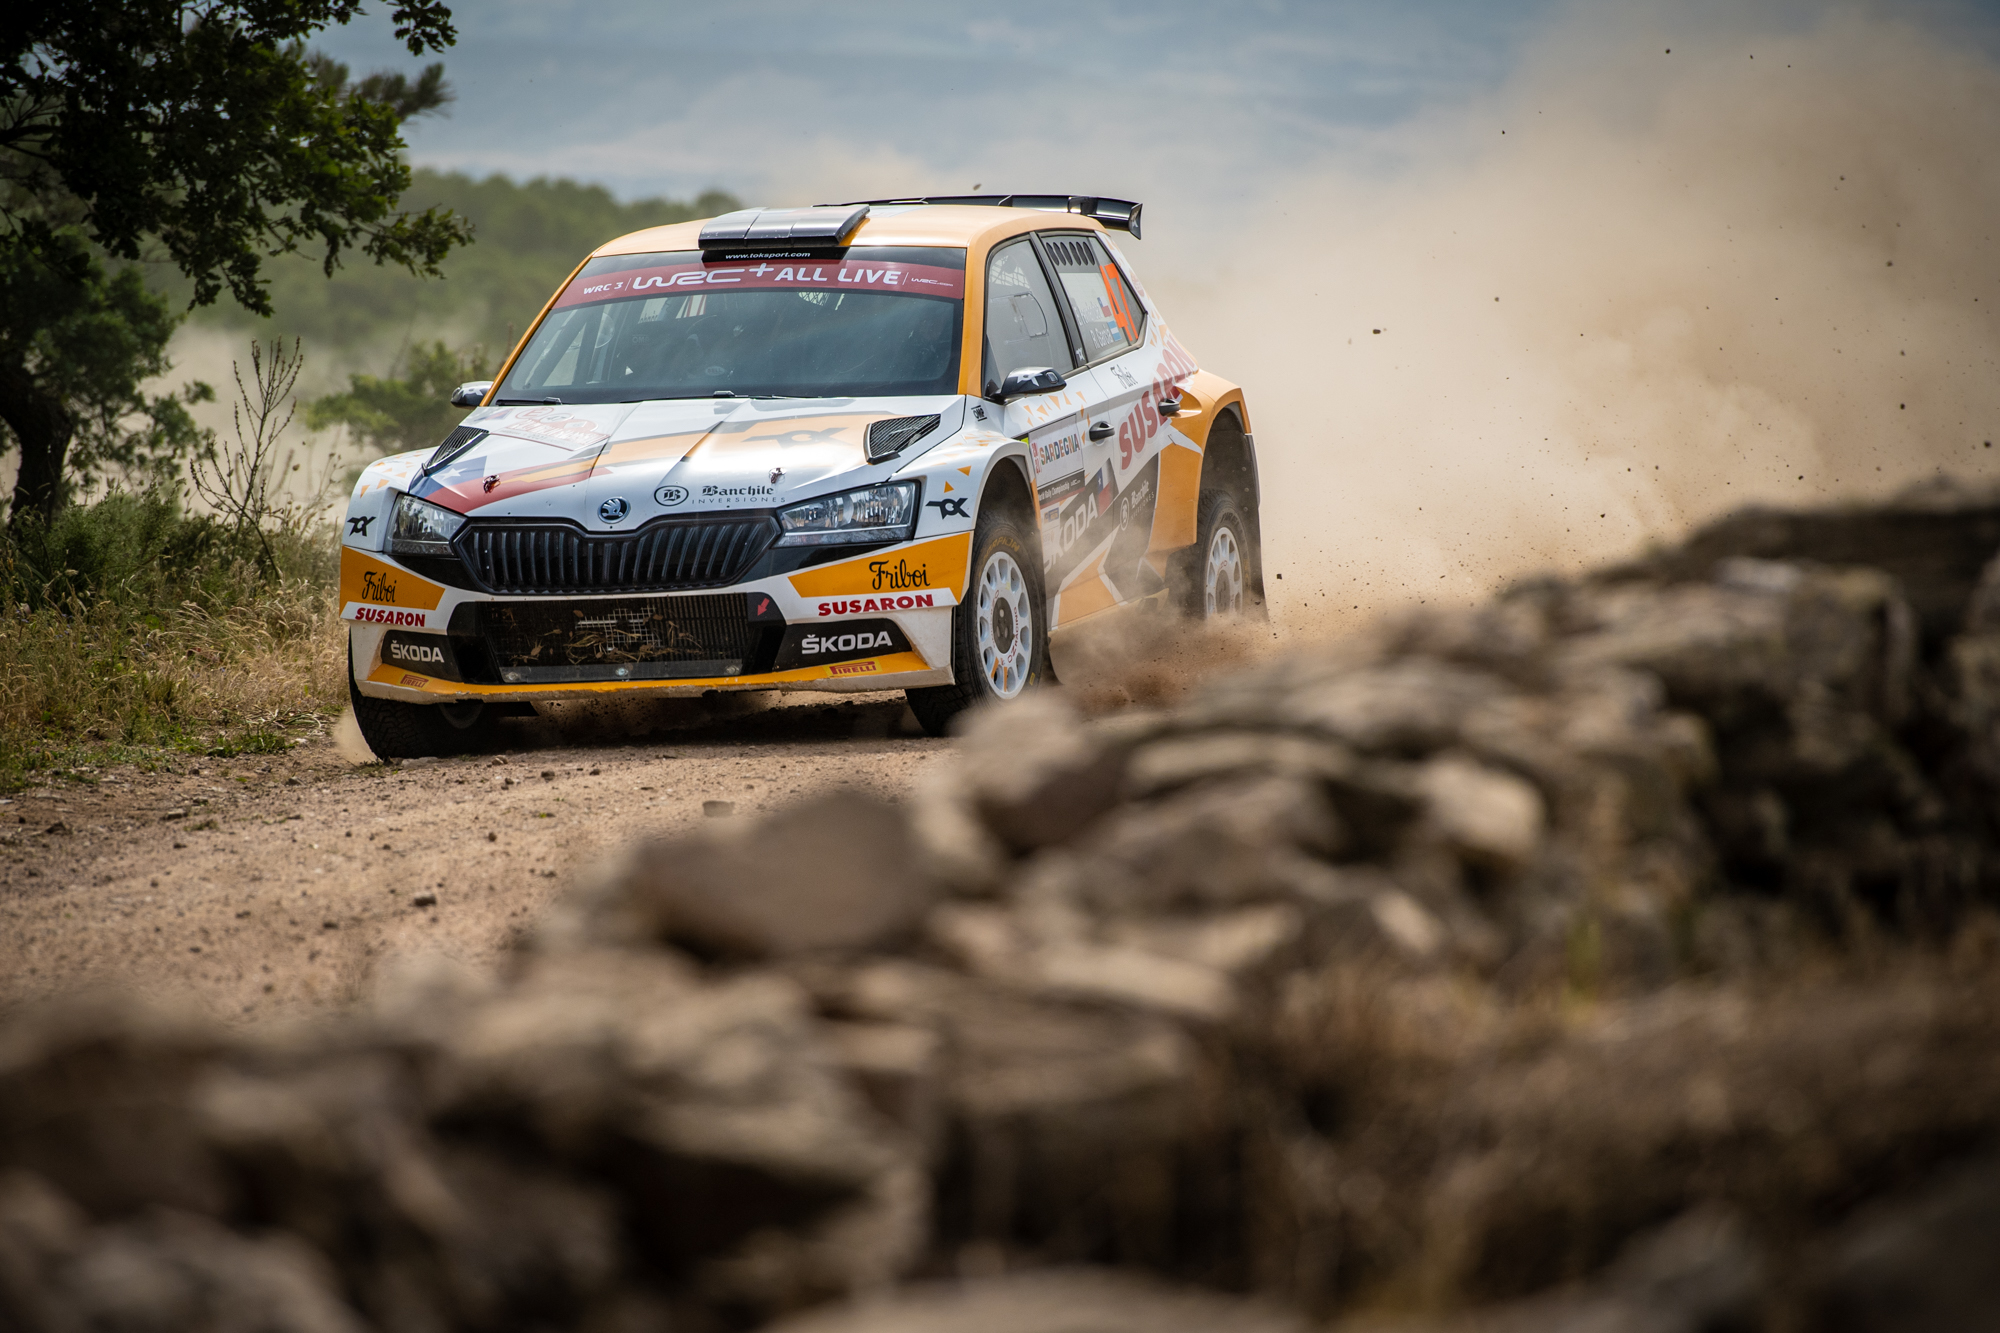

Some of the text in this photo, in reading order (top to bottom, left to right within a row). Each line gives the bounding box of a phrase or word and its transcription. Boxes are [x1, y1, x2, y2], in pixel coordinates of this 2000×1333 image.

[725, 252, 811, 260] www.toksport.com
[774, 267, 828, 282] ALL
[837, 268, 902, 285] LIVE
[583, 282, 624, 295] WRC 3
[1099, 262, 1139, 342] 47
[1039, 433, 1080, 465] SARDEGNA
[692, 497, 787, 505] INVERSIONES
[702, 485, 775, 497] Banchile
[868, 558, 931, 591] Friboi
[361, 570, 397, 603] Friboi
[818, 594, 934, 617] SUSARON
[355, 607, 426, 628] SUSARON
[390, 640, 445, 663] ŠKODA
[801, 631, 893, 655] ŠKODA
[829, 660, 877, 675] PIRELLI
[400, 673, 430, 688] PIRELLI
